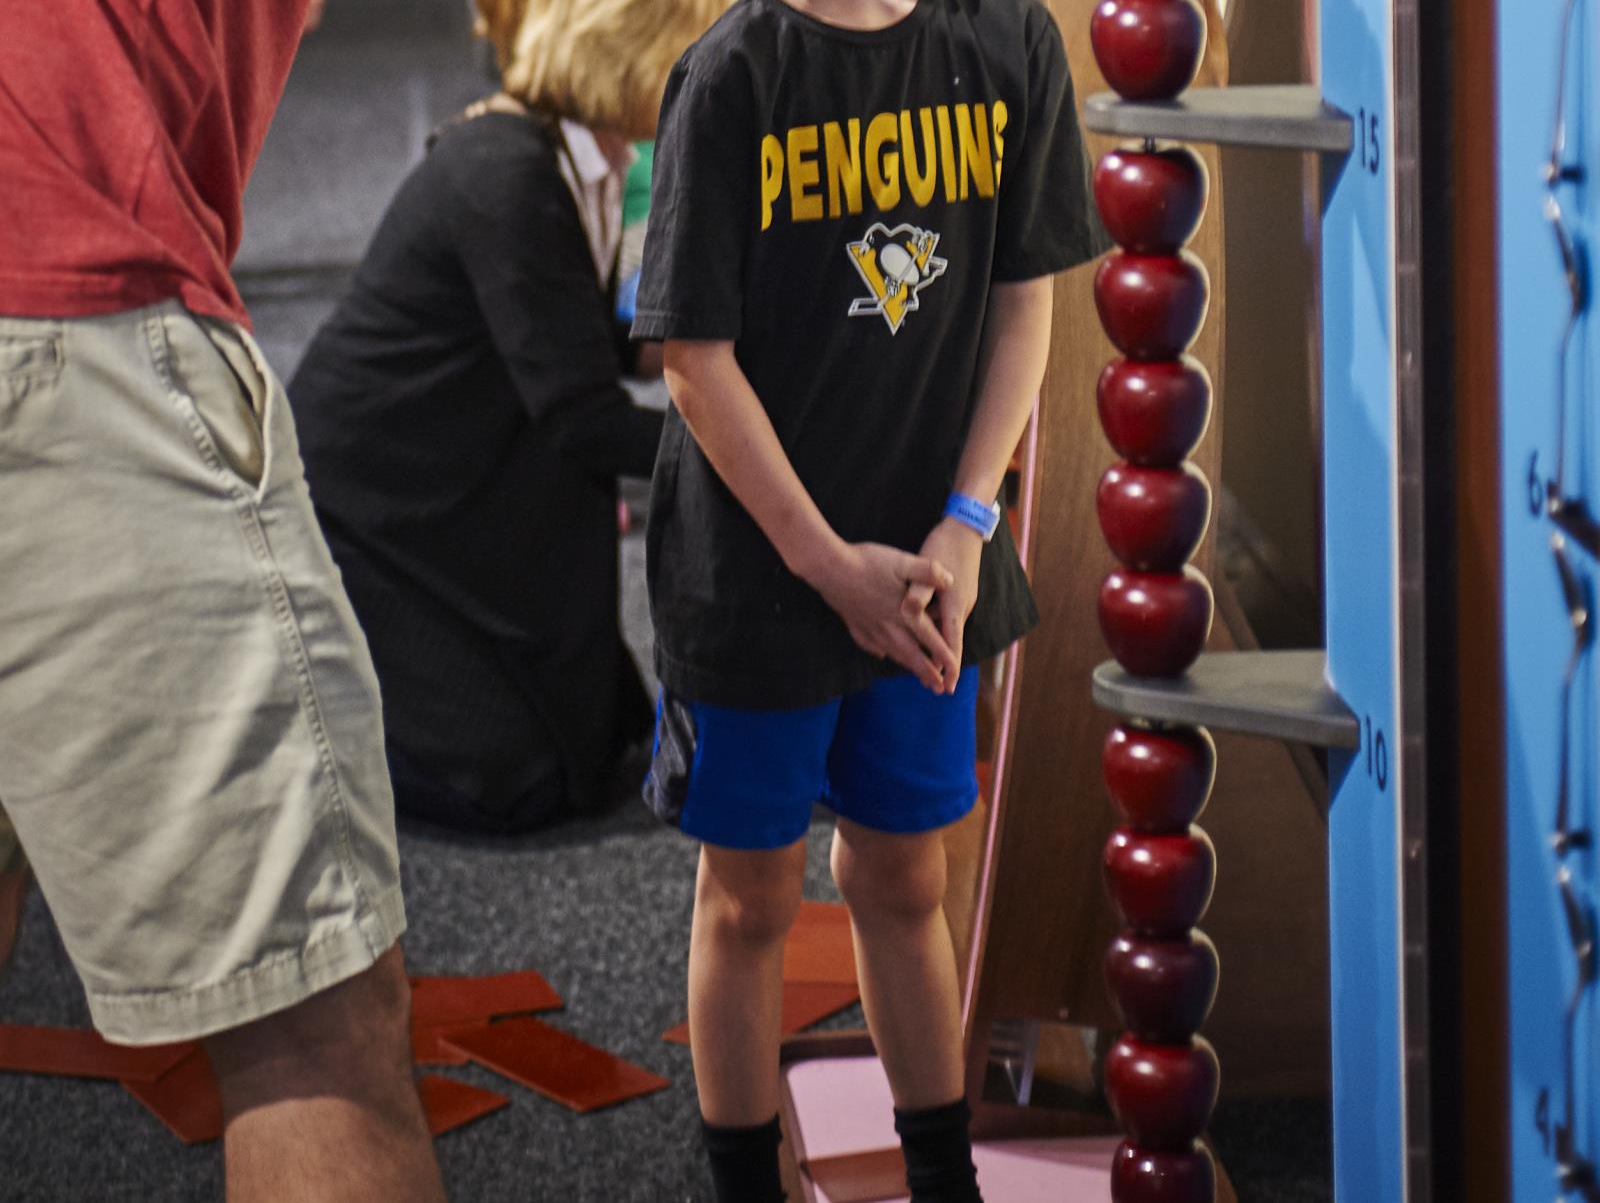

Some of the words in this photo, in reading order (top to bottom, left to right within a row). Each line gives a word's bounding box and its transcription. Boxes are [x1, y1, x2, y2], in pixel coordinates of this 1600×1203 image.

[760, 100, 1008, 232] PENGUINS
[1358, 106, 1380, 177] 15
[1527, 447, 1544, 520] 6
[1365, 712, 1388, 793] 10
